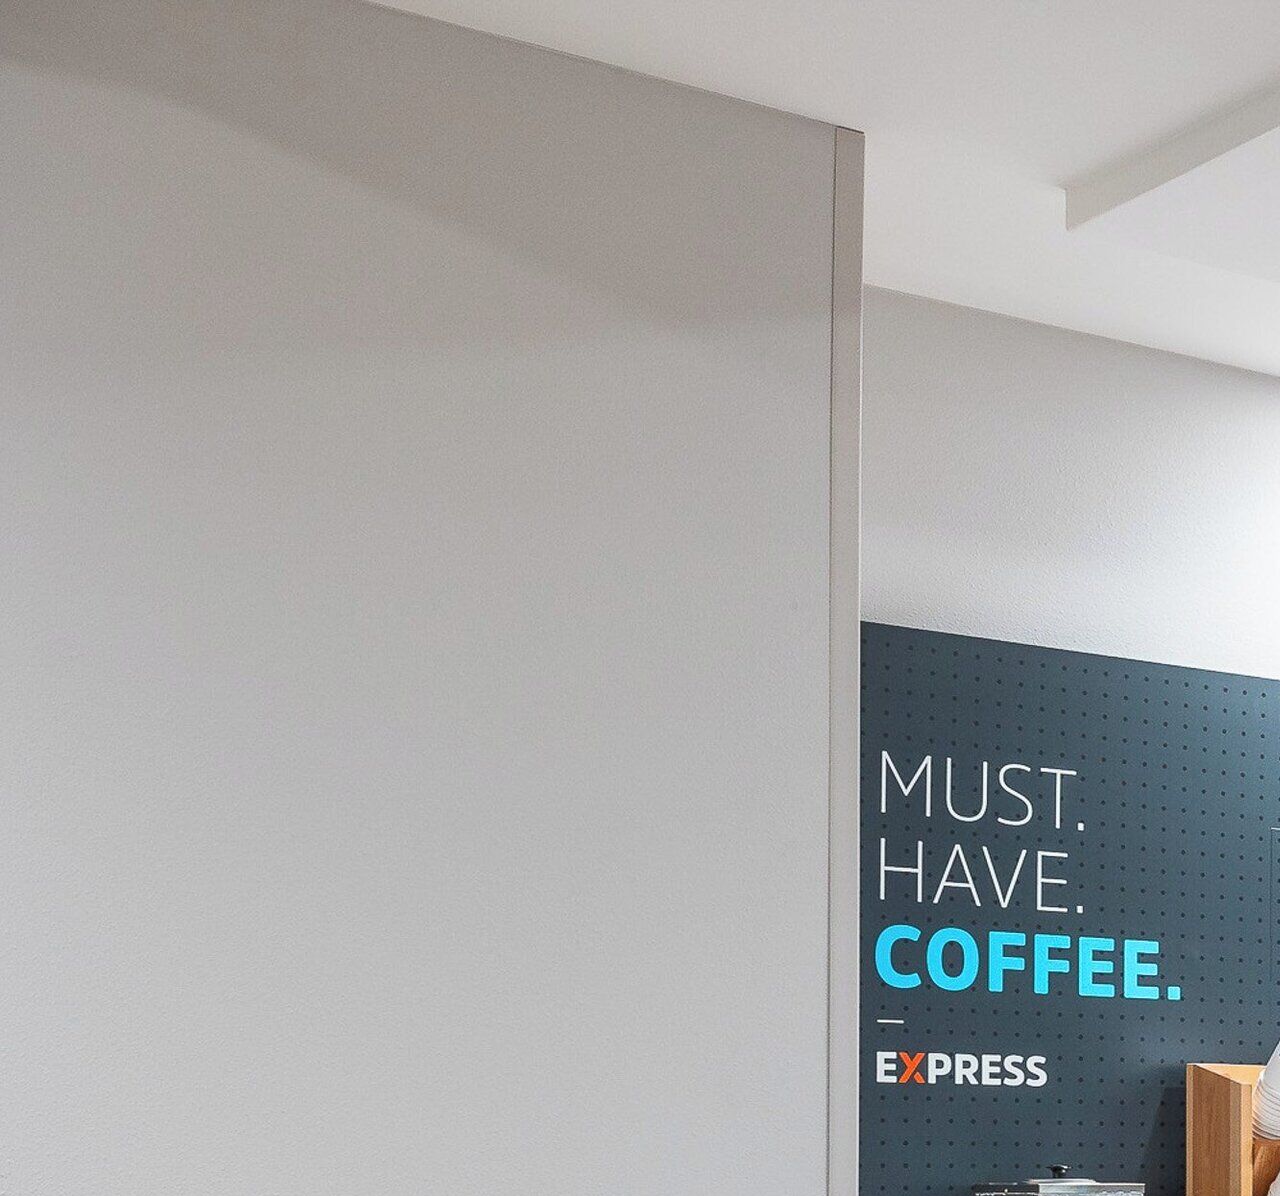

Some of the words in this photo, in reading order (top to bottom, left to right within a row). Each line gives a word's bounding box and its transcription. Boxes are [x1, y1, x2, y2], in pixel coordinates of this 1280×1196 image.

[880, 749, 1086, 832] MUST.
[879, 836, 1084, 914] HAVE.
[874, 923, 1182, 1001] COFFEE.
[875, 1050, 1049, 1088] EXPRESS
